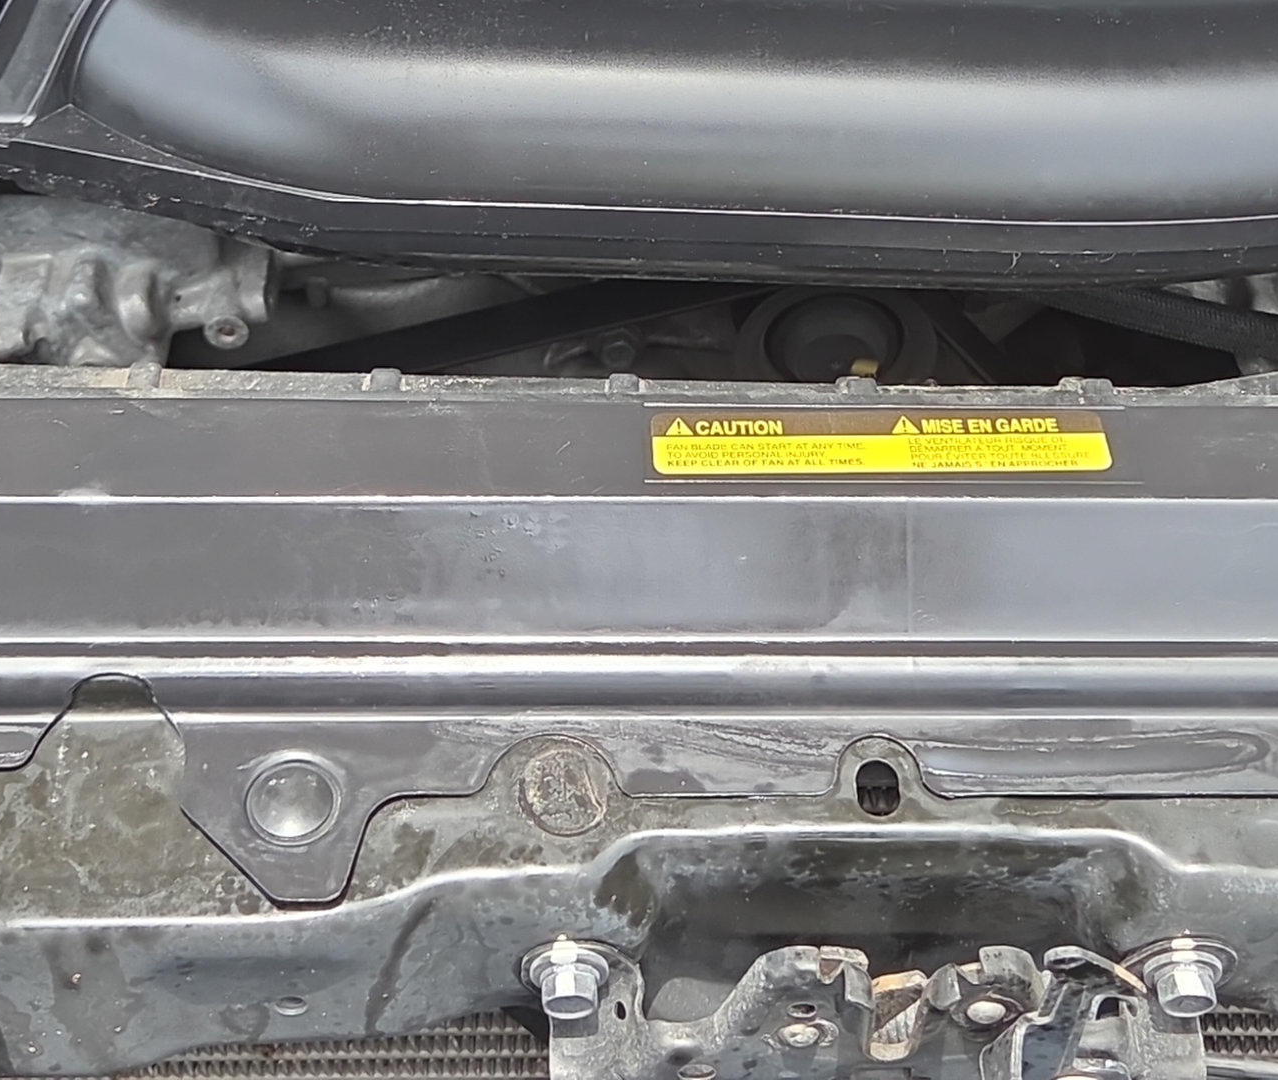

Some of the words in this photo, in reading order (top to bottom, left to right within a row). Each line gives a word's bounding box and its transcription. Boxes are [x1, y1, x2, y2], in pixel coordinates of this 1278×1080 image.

[695, 420, 783, 435] CAUTION
[921, 419, 965, 434] MISE
[967, 418, 992, 433] EN
[995, 418, 1059, 433] GARDE
[925, 437, 1001, 445] VENTILATEUR
[666, 443, 688, 451] FAN
